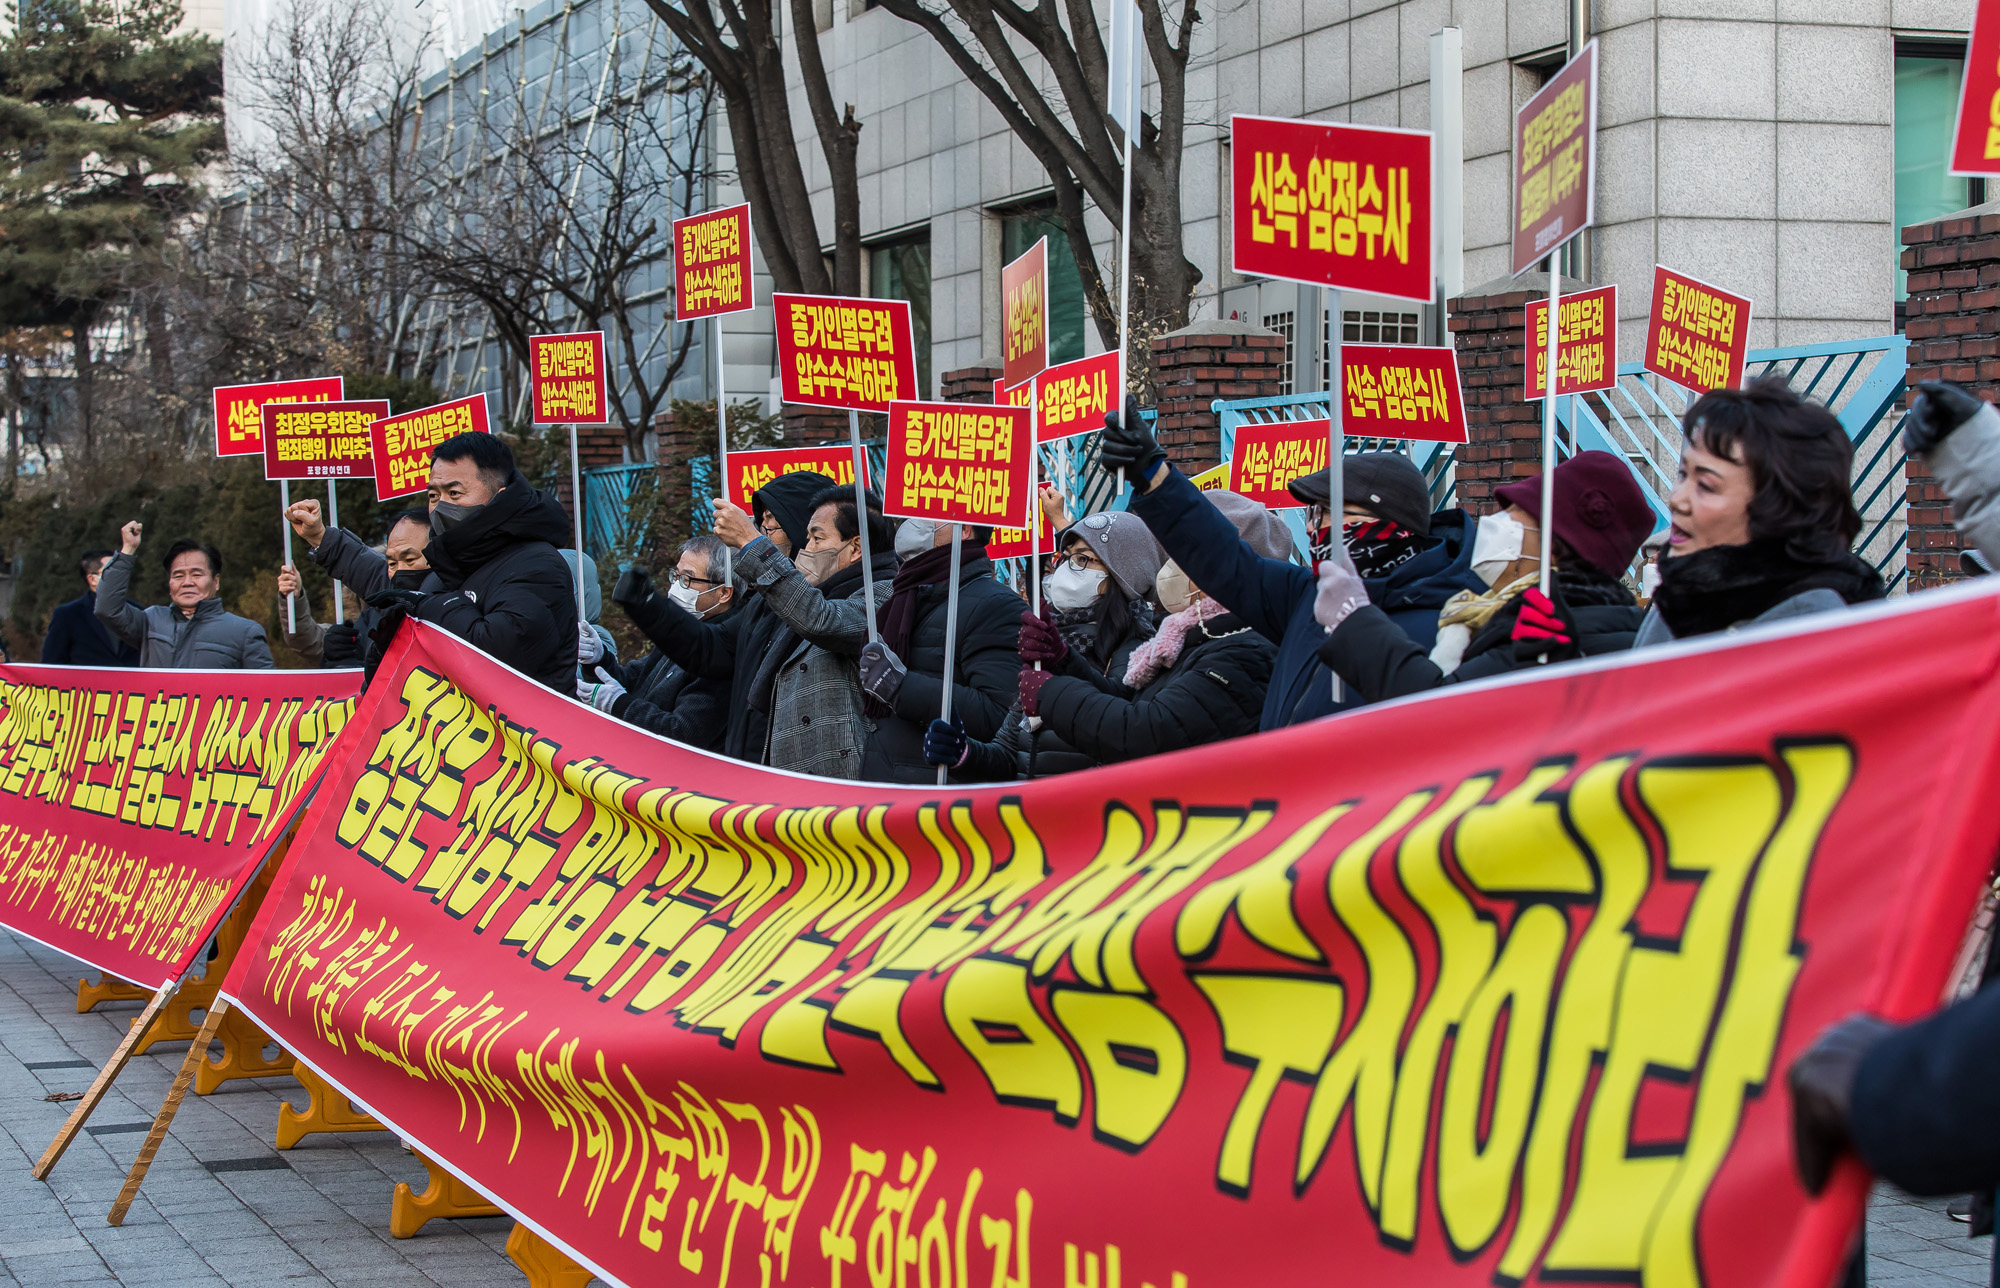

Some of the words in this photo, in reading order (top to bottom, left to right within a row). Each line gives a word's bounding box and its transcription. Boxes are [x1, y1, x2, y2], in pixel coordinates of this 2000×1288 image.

[1251, 151, 1411, 265] 신속·엄정수사
[682, 214, 740, 267] 증거인멸우려
[684, 261, 742, 311] 압수수색하라
[1661, 278, 1737, 347] 증거인멸우려
[790, 303, 894, 355] 증거인멸우려
[1536, 296, 1604, 347] 증인멸우려
[539, 340, 594, 377] 증거인멸우려
[795, 352, 898, 403] 압수수색하라
[1536, 341, 1605, 391] 압수색하라
[1656, 325, 1731, 390] 압수수색하라
[541, 380, 596, 417] 압수수색하라
[1346, 364, 1450, 423] 신속·엄정수사
[275, 411, 377, 436] 최정우회장의
[276, 437, 327, 461] 범죄행위
[384, 404, 474, 456] 증거인멸우려
[905, 410, 1013, 464] 증거인멸우려
[306, 465, 351, 476] 포항참여연대
[389, 452, 432, 491] 압수수
[902, 462, 1010, 517] 압수수색하라
[0, 677, 92, 807] 거인멸우려!!
[335, 665, 496, 884] 경찰은
[413, 703, 584, 935] 최정우
[499, 755, 661, 972] 회장
[262, 874, 358, 1018] 최정우
[306, 916, 414, 1056] 퇴출!
[354, 960, 457, 1082] 포스코
